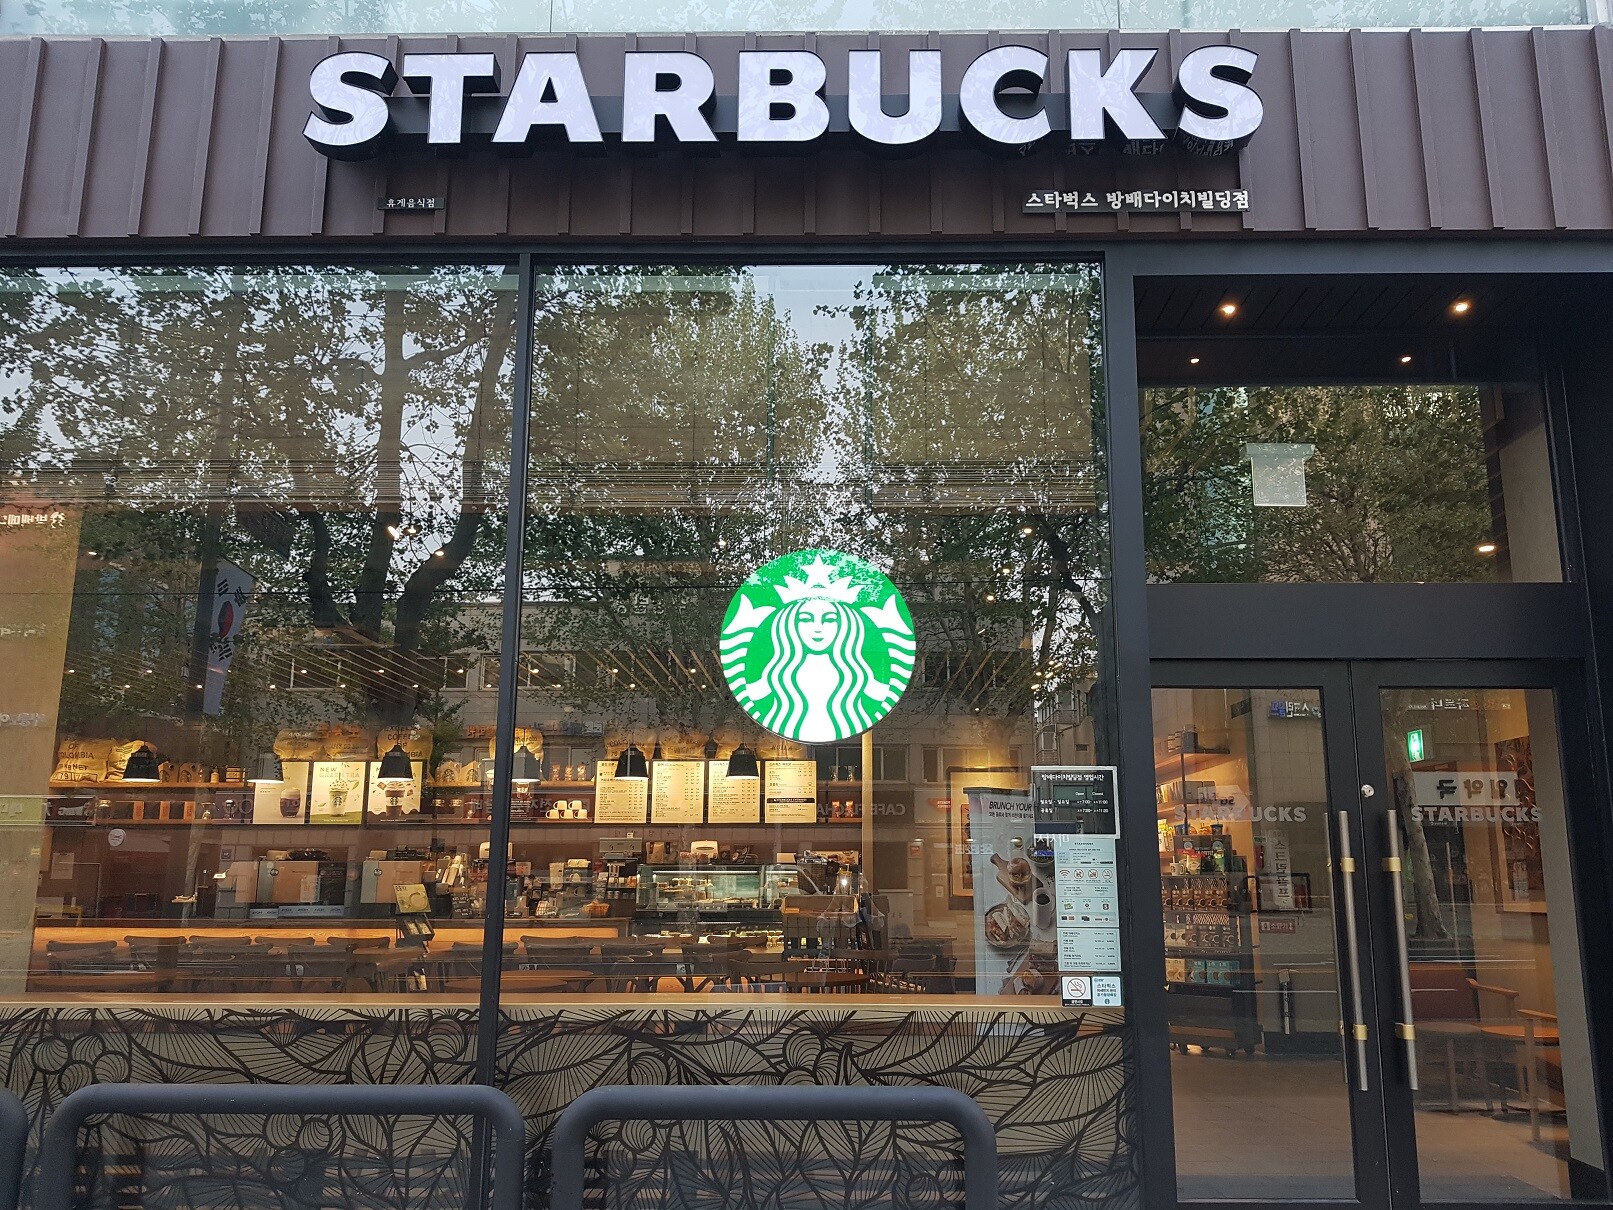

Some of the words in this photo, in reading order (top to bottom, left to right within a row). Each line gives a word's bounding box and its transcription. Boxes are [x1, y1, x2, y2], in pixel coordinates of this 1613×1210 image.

[302, 45, 1264, 150] STARBUCKS
[385, 197, 436, 210] 휴게음식점
[1025, 190, 1099, 209] 스타벅스
[1106, 189, 1249, 211] 방배다이치빌딩점
[988, 800, 1015, 811] BRUNCH
[1015, 802, 1033, 812] YOUR
[1174, 805, 1307, 824] STARBUCKS
[1411, 805, 1543, 824] STARBUCKS
